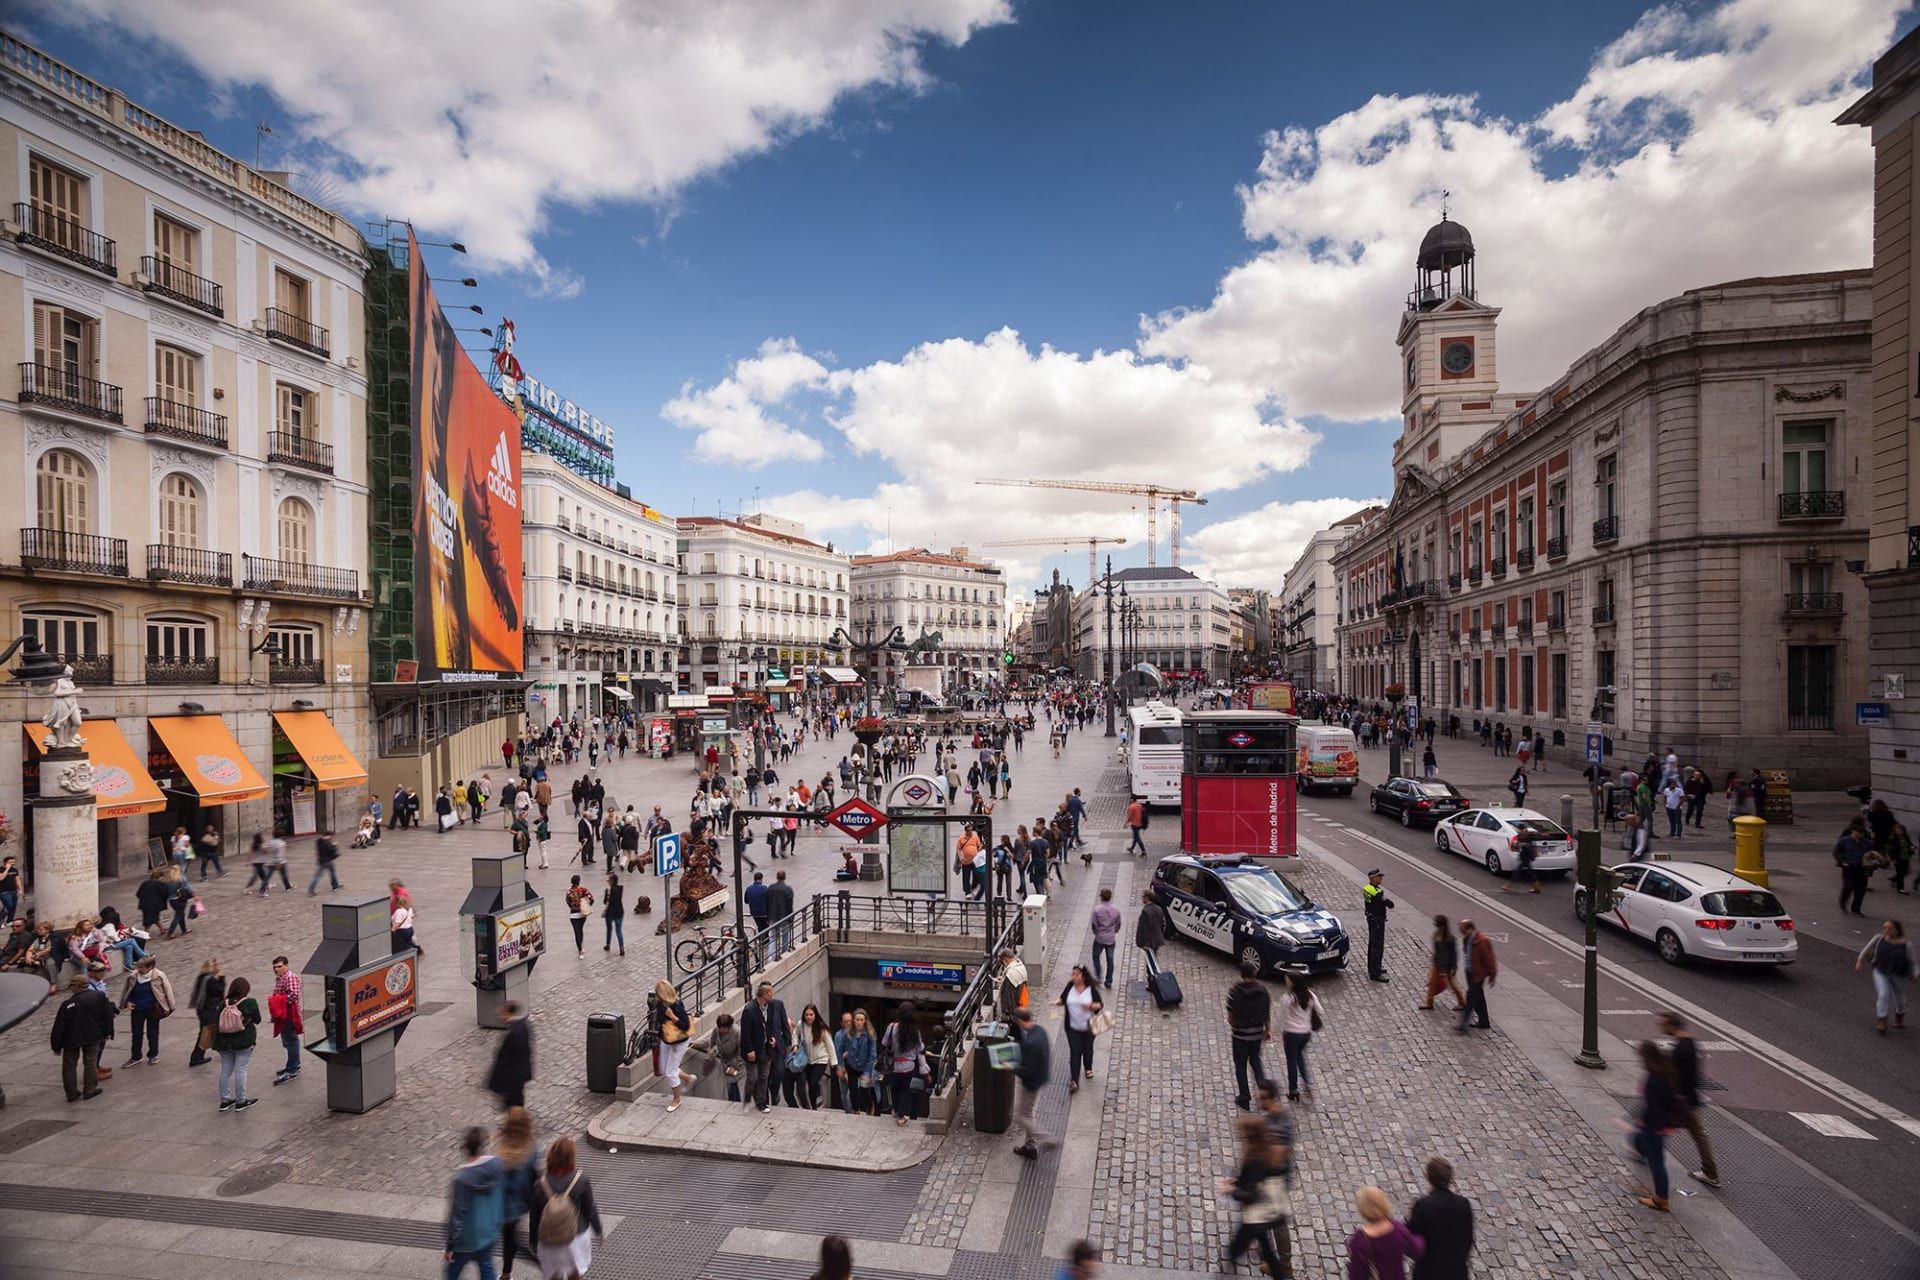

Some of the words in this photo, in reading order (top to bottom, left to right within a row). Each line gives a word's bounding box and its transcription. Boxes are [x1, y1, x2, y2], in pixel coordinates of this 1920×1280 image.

[525, 373, 560, 416] TIO
[565, 399, 615, 448] PERE
[425, 469, 458, 531] DESTROY
[487, 470, 517, 509] adidas
[430, 511, 454, 561] ORDER
[1269, 782, 1278, 812] Madrid
[842, 814, 870, 825] Metro
[1269, 816, 1278, 827] de
[1269, 827, 1278, 854] Metro
[662, 840, 676, 870] P
[1168, 897, 1235, 935] POLICÍA
[1186, 922, 1215, 940] MADRID
[904, 967, 932, 975] vodafone
[354, 984, 378, 1005] Ria
[352, 1004, 381, 1021] CAMBIO
[357, 1018, 369, 1029] NO
